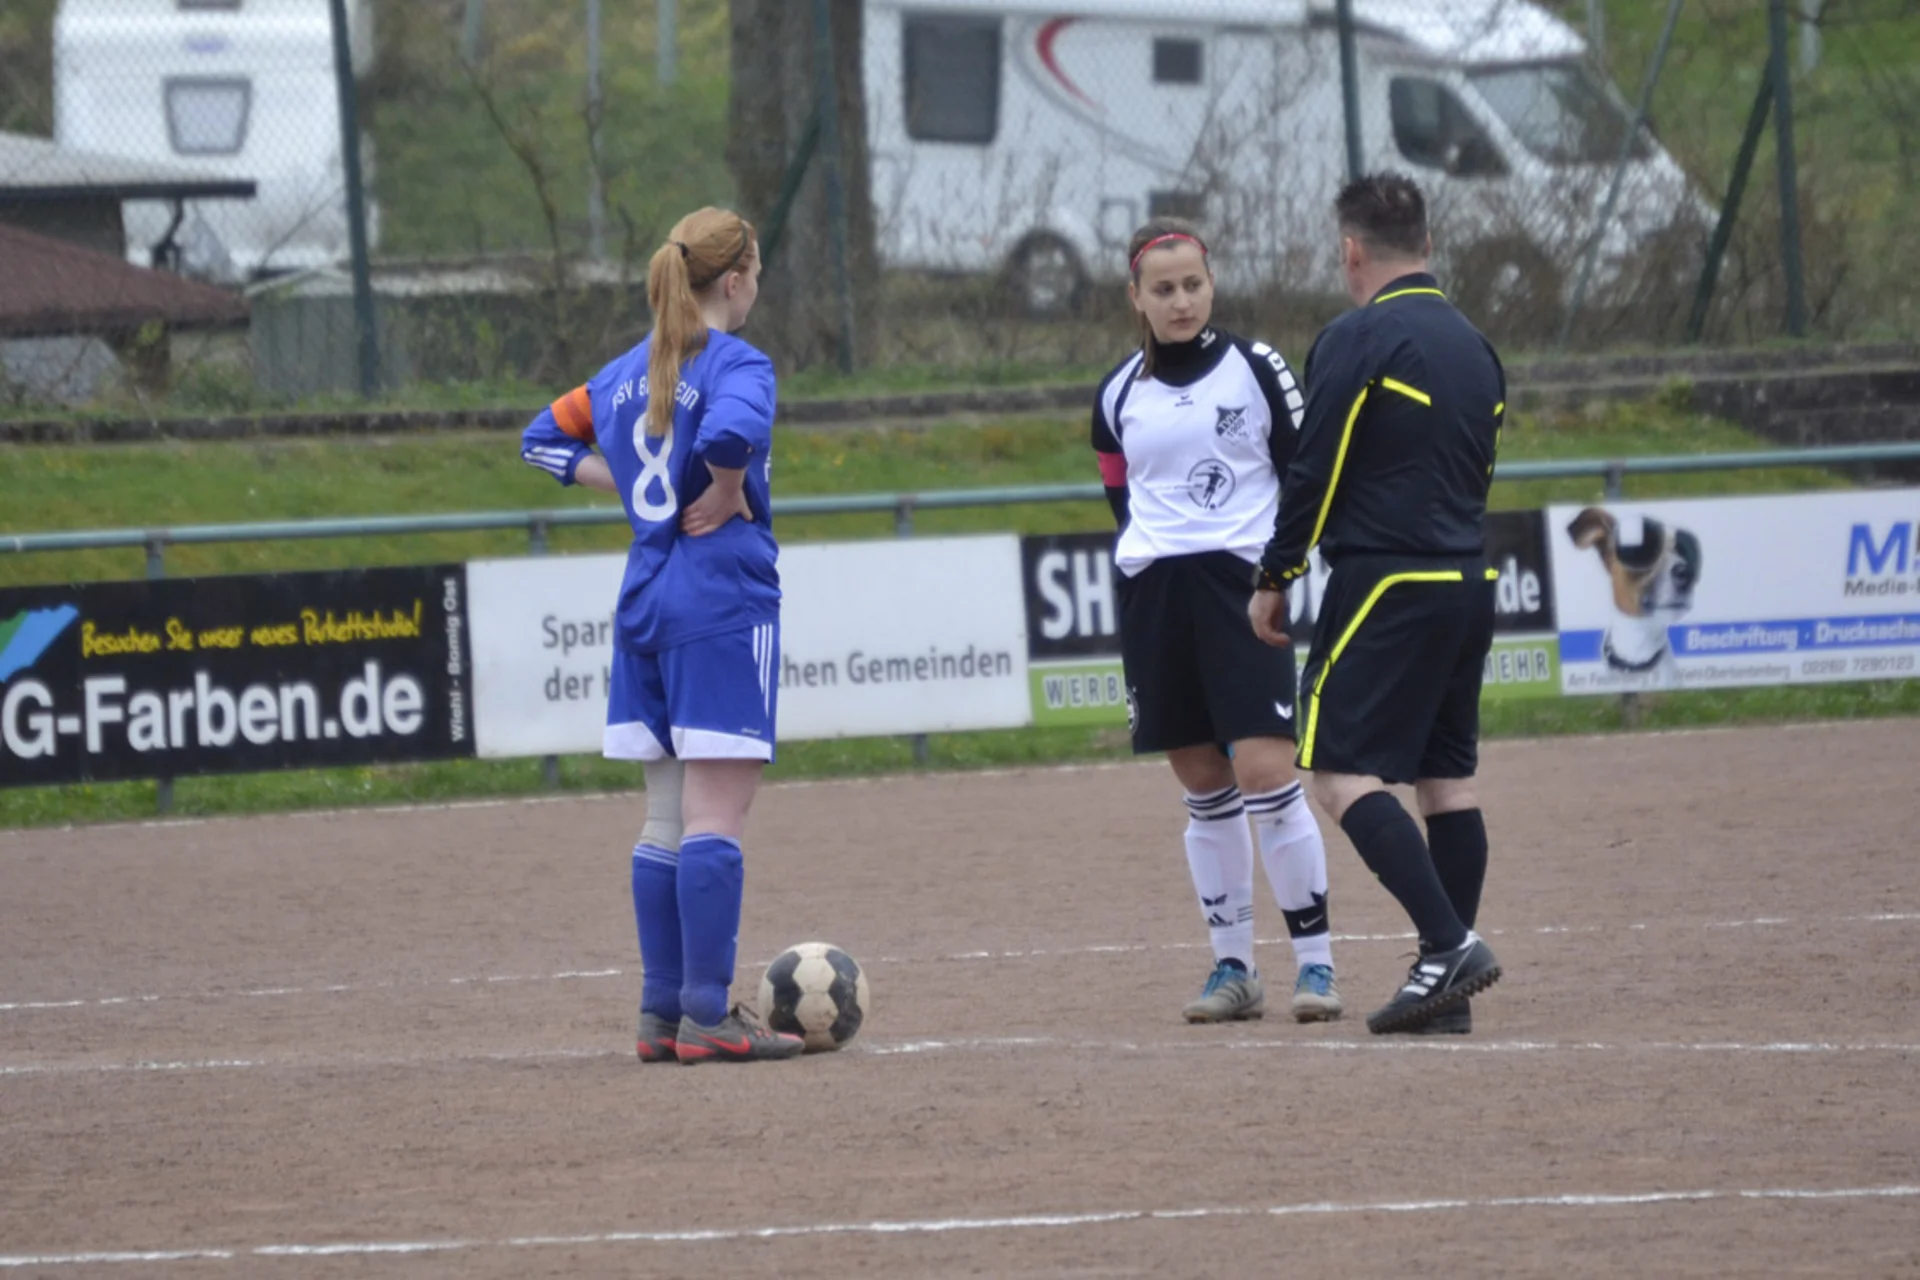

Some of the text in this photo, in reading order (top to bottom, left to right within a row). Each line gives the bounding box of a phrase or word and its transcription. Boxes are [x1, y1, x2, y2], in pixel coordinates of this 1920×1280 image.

[631, 409, 678, 522] 8
[81, 620, 161, 658] Besuchen
[165, 616, 194, 650] Sie
[199, 626, 244, 649] unser
[250, 624, 299, 646] neues
[1687, 625, 1798, 650] Beschriftung
[544, 664, 594, 702] der
[777, 653, 839, 688] hen
[846, 643, 1013, 685] Gemeinden
[1044, 671, 1121, 707] WERB
[2, 660, 423, 759] G-Farben.de
